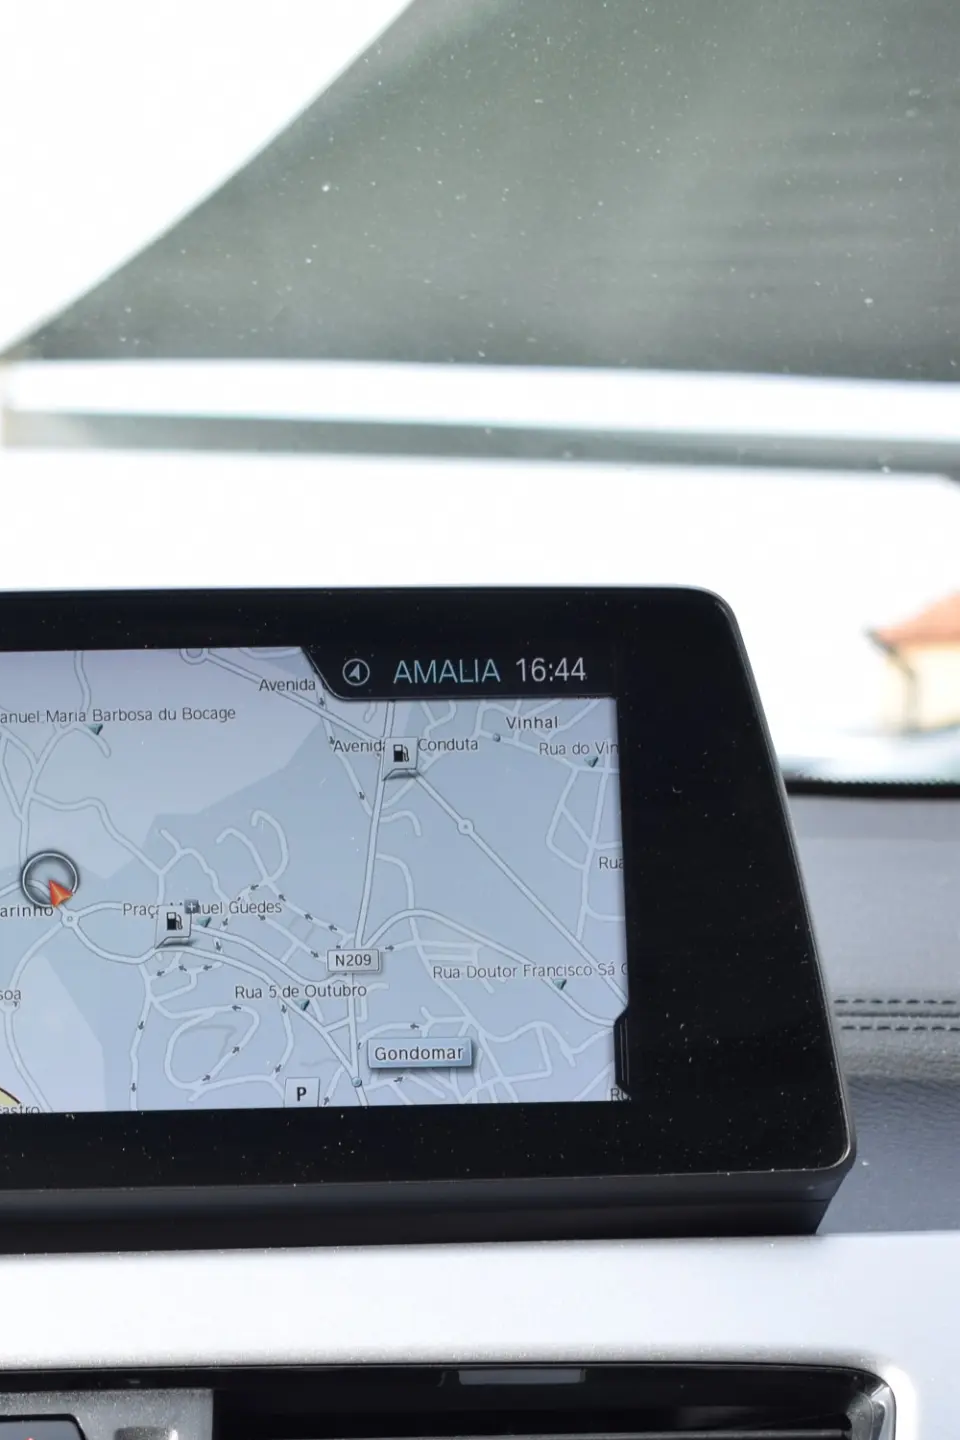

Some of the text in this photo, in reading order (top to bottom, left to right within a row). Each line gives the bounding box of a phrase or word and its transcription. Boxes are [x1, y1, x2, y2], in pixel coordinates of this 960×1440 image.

[393, 659, 501, 684] AMALIA
[516, 657, 587, 682] 16:44
[258, 677, 316, 693] Avenida
[46, 708, 86, 723] Maria
[92, 707, 153, 722] Barbosa
[159, 706, 177, 720] du
[182, 705, 236, 722] Bocage
[506, 715, 559, 730] Vinhal
[417, 737, 479, 752] Conduta
[540, 742, 566, 756] Rua
[572, 741, 590, 755] do
[229, 900, 282, 914] Guedes
[335, 954, 372, 968] N209
[433, 965, 461, 979] Rua
[466, 964, 517, 979] Doutor
[523, 963, 593, 978] Francisco
[597, 960, 615, 976] Sá
[235, 984, 367, 1000] Rua 5 de Outubro
[374, 1045, 464, 1063] Gondomar
[296, 1086, 307, 1102] P
